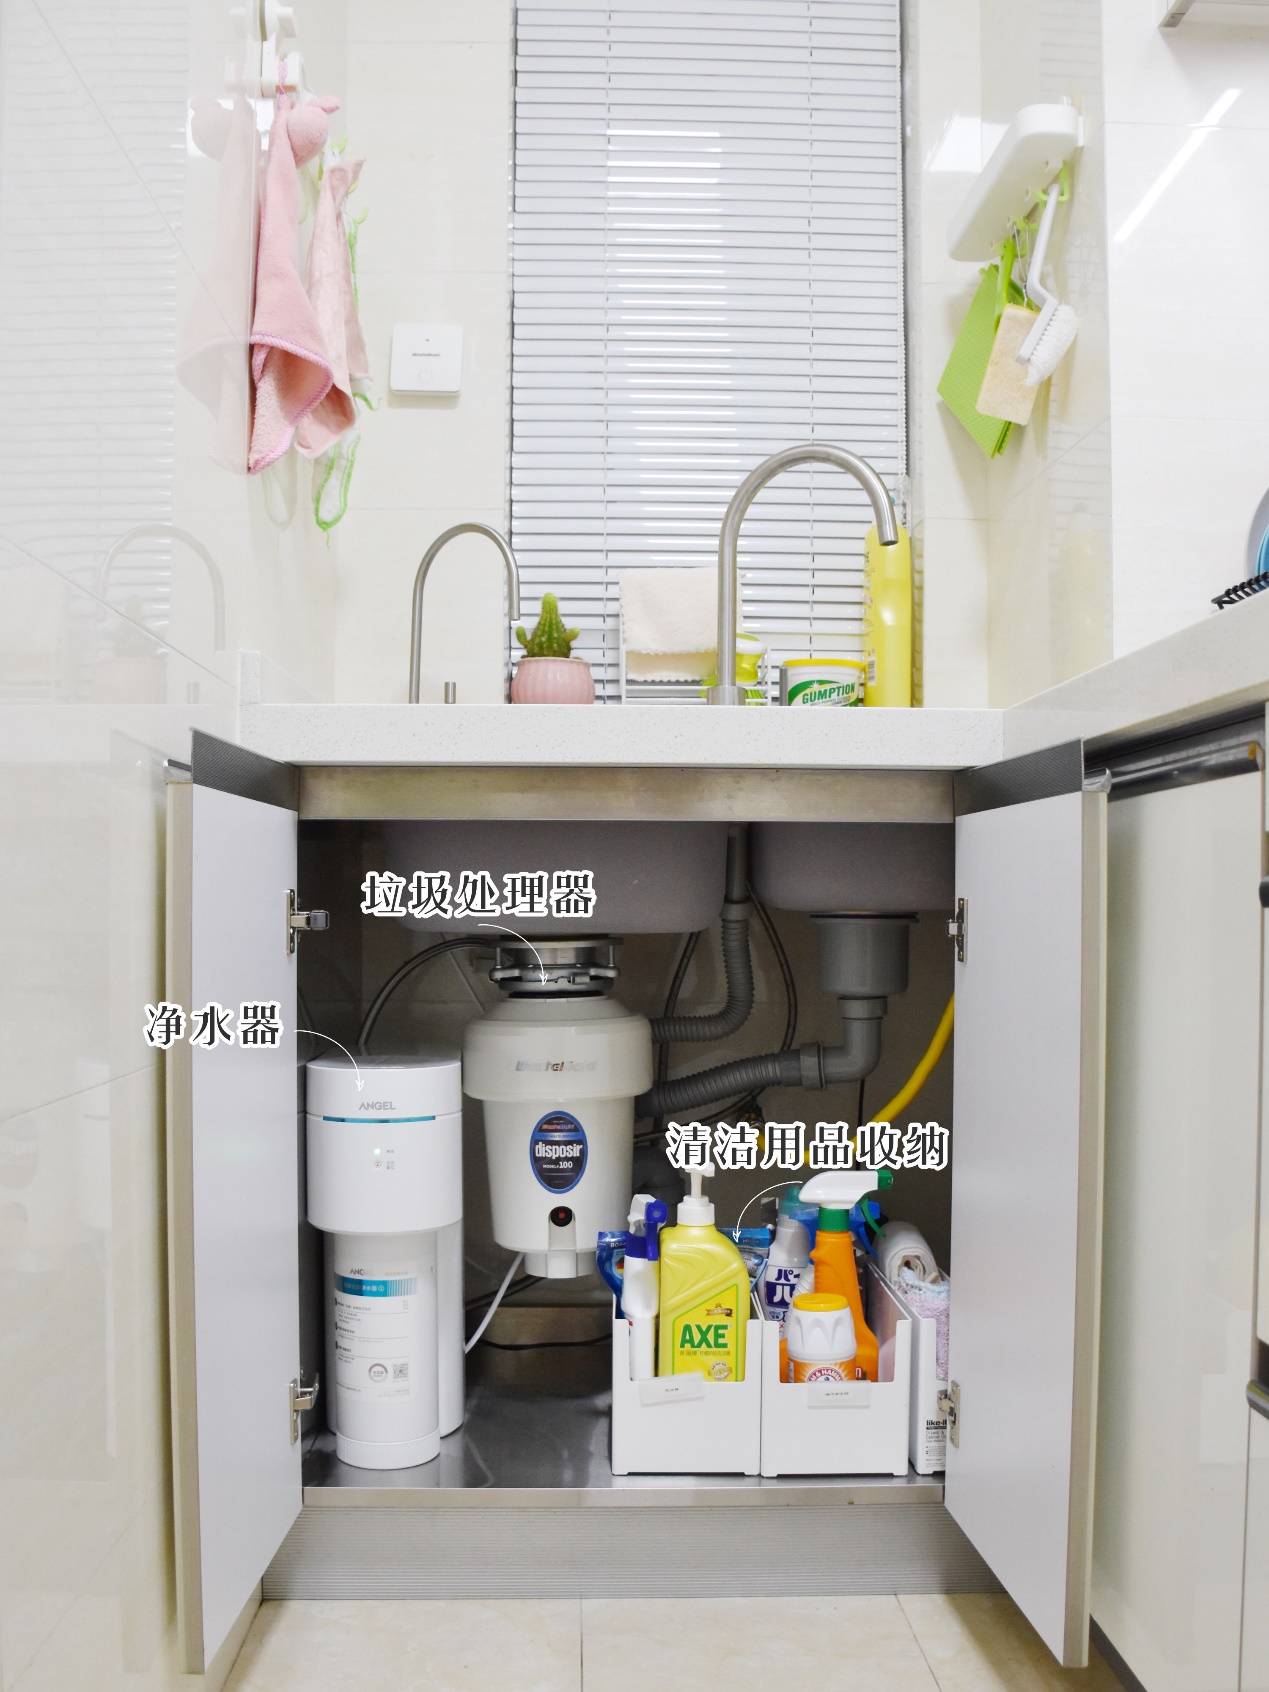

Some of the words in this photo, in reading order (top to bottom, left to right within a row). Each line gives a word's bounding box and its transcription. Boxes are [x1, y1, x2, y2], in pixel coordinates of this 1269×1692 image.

[802, 682, 856, 704] GUMPTION
[358, 1101, 396, 1111] ANGEL
[535, 1141, 583, 1160] disposir
[679, 1323, 729, 1349] AXE
